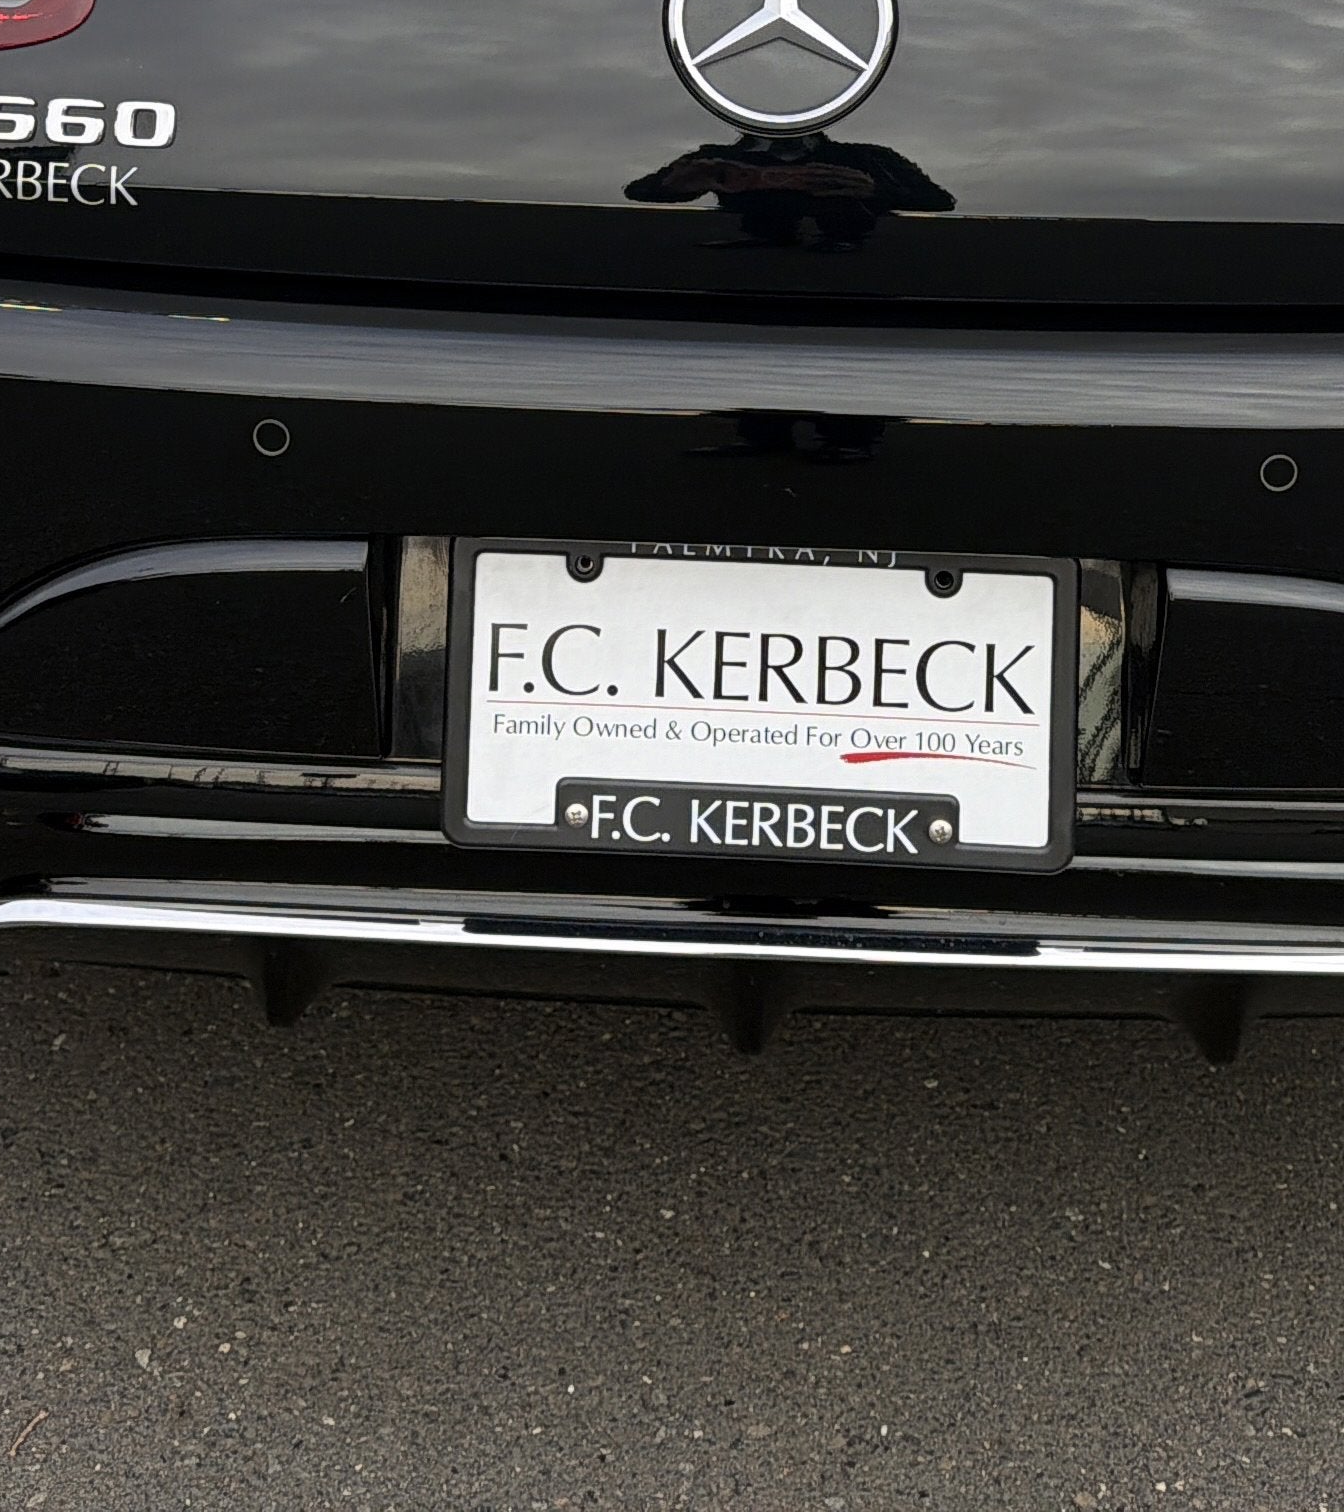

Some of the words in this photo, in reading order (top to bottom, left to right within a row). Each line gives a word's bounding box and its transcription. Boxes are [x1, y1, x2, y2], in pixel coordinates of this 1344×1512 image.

[488, 622, 619, 696] F.C.
[654, 628, 1036, 715] KERBECK
[493, 713, 566, 741] Family
[573, 715, 657, 740] Owned
[665, 719, 683, 741] &
[690, 719, 799, 748] Operated
[806, 726, 843, 748] For
[850, 727, 907, 751] Over
[915, 731, 956, 753] 100
[964, 734, 1024, 757] Years
[590, 794, 672, 843] F.C.
[690, 798, 920, 855] KERBECK
